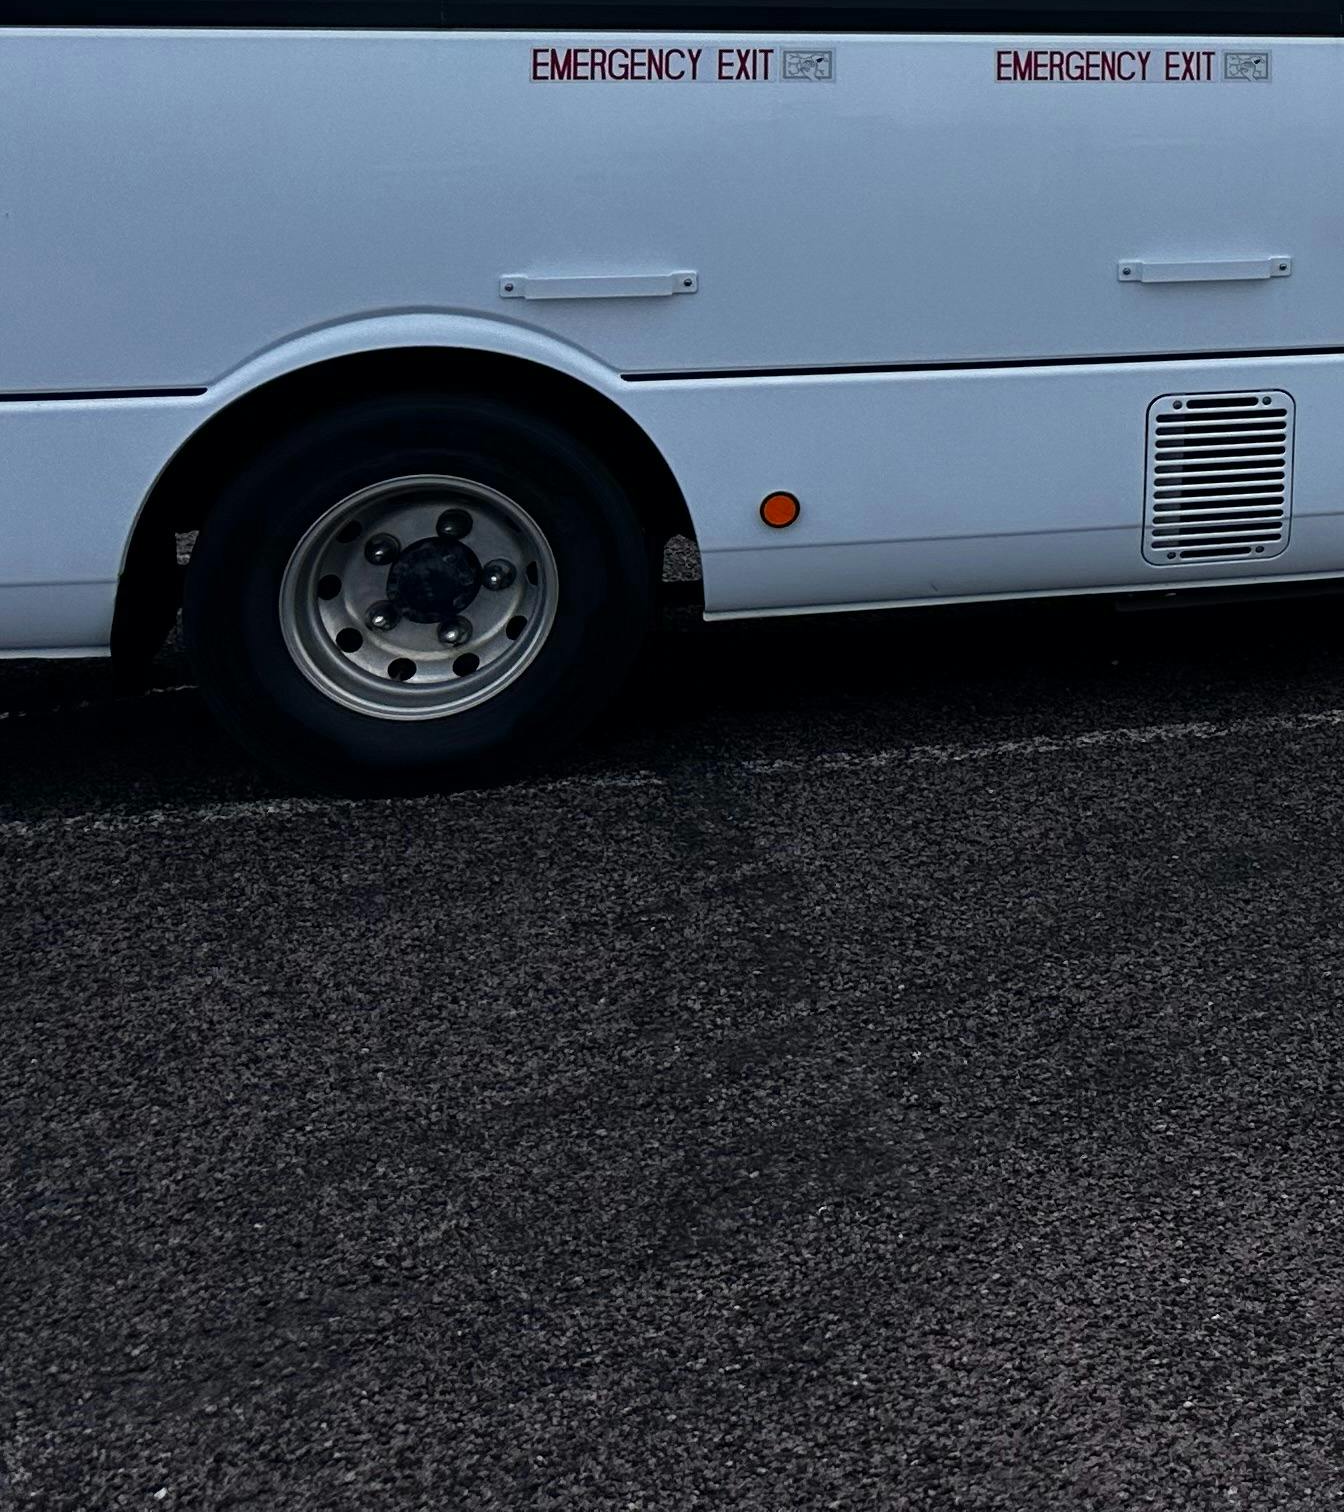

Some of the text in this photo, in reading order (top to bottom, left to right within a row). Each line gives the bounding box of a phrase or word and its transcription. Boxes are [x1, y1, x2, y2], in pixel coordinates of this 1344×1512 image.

[532, 48, 775, 81] EMERGENCY EXIT
[995, 50, 1216, 82] EMERGENCY EXIT
